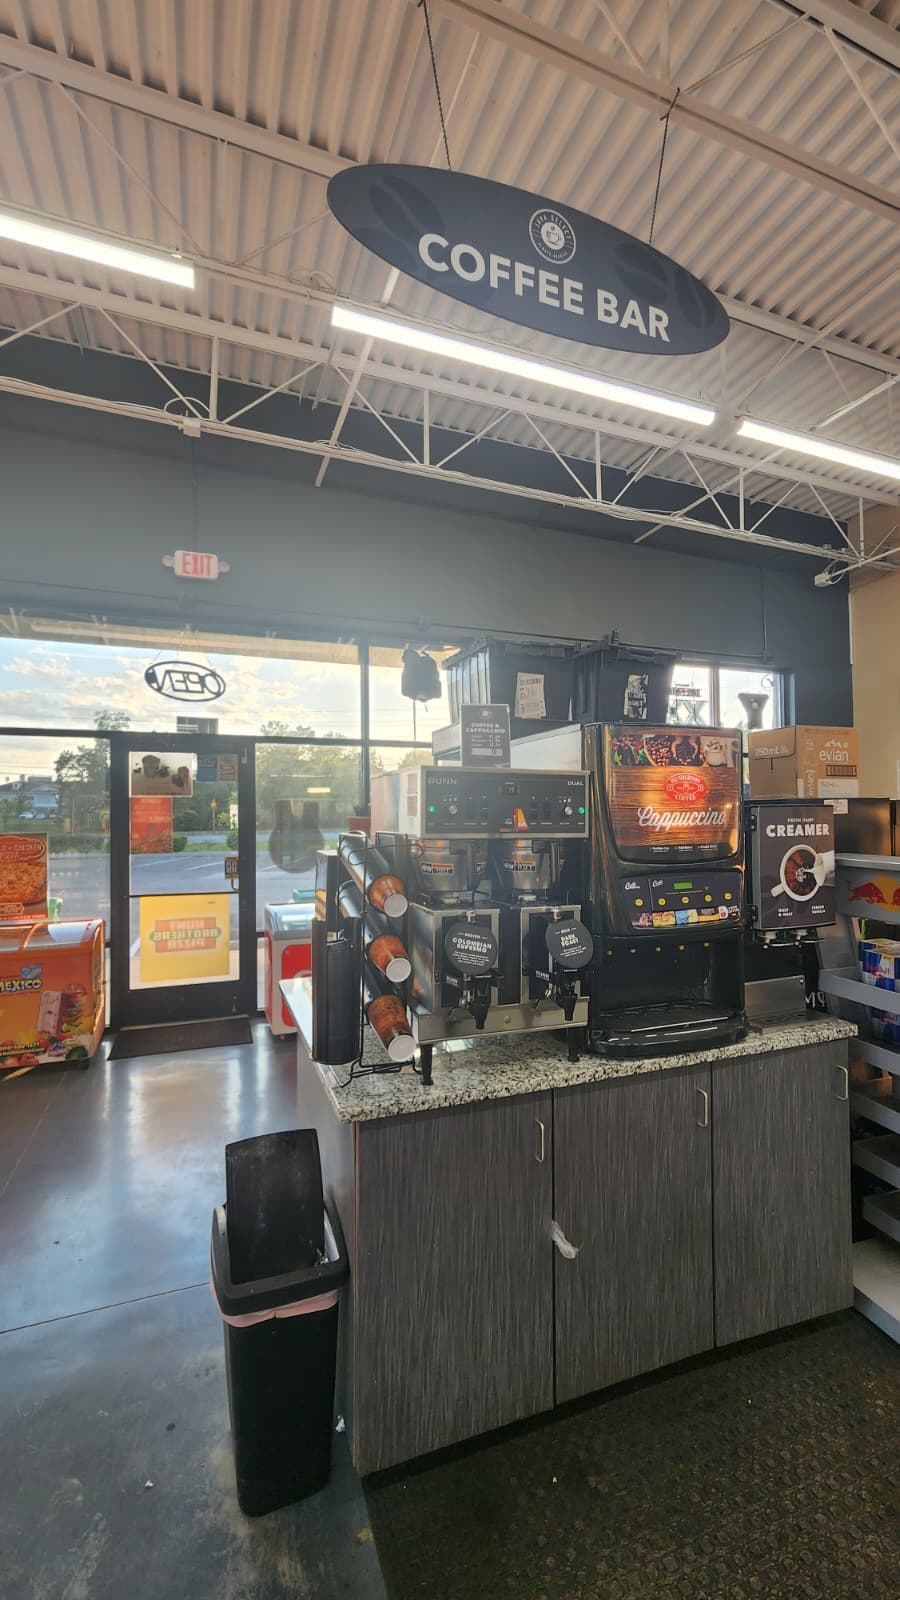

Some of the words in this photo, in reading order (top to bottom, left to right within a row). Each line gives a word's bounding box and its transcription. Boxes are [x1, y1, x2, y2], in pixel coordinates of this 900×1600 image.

[550, 213, 572, 239] SELECT
[418, 233, 584, 316] COFFEE
[596, 288, 671, 343] BAR
[182, 552, 213, 577] EXIT
[819, 749, 849, 761] evian
[427, 775, 457, 785] BUNN
[637, 805, 728, 832] Cappuccino
[766, 823, 830, 838] CREAMER
[452, 937, 492, 950] COLOMBIAN
[456, 943, 487, 954] SUPREMO
